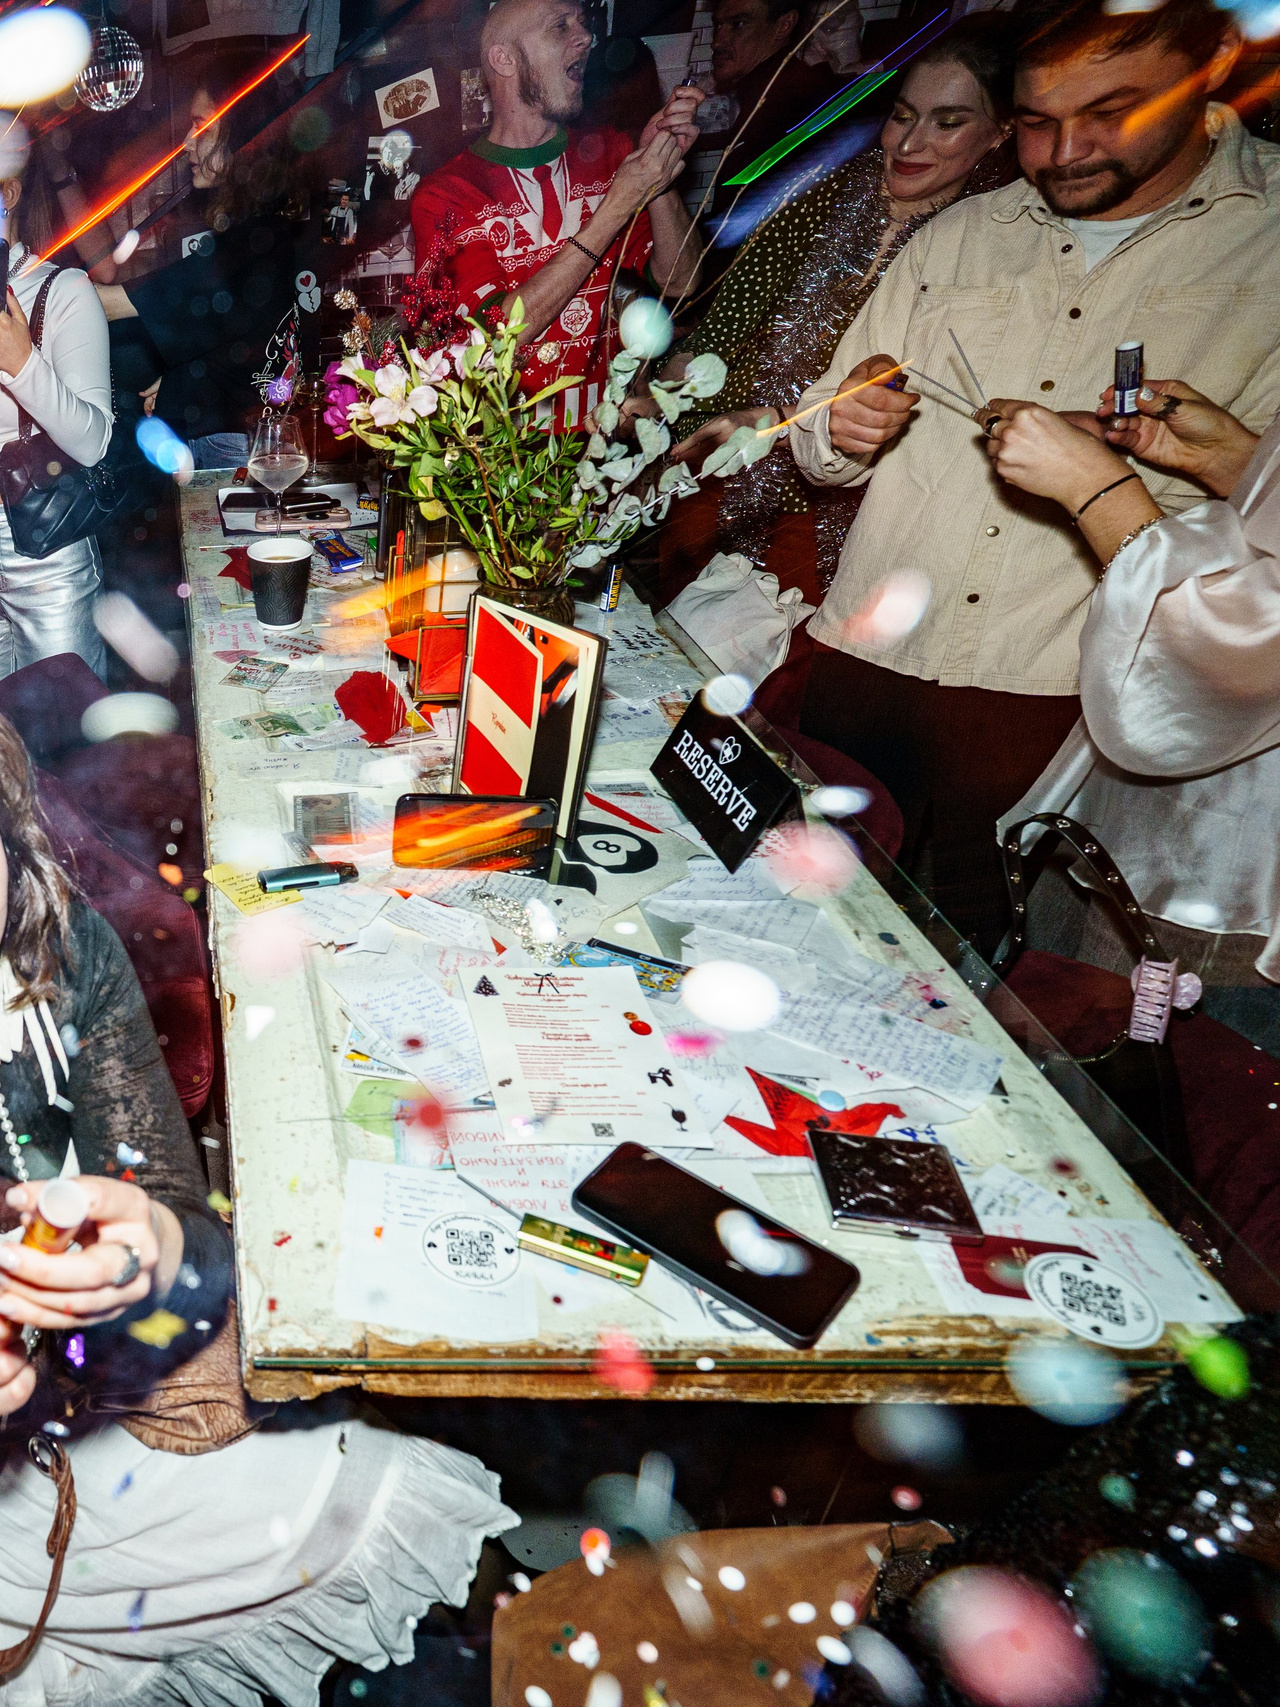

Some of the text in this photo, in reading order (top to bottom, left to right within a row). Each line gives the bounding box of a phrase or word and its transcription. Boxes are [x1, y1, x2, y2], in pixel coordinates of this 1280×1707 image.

[672, 729, 757, 832] RESERVE
[592, 840, 621, 853] 8
[460, 1156, 565, 1167] ОБЯЗАТЕЛЬНО
[516, 1167, 527, 1177] И
[481, 1178, 569, 1190] ЭТУ ЖИЗНЬ
[558, 1199, 569, 1212] Я
